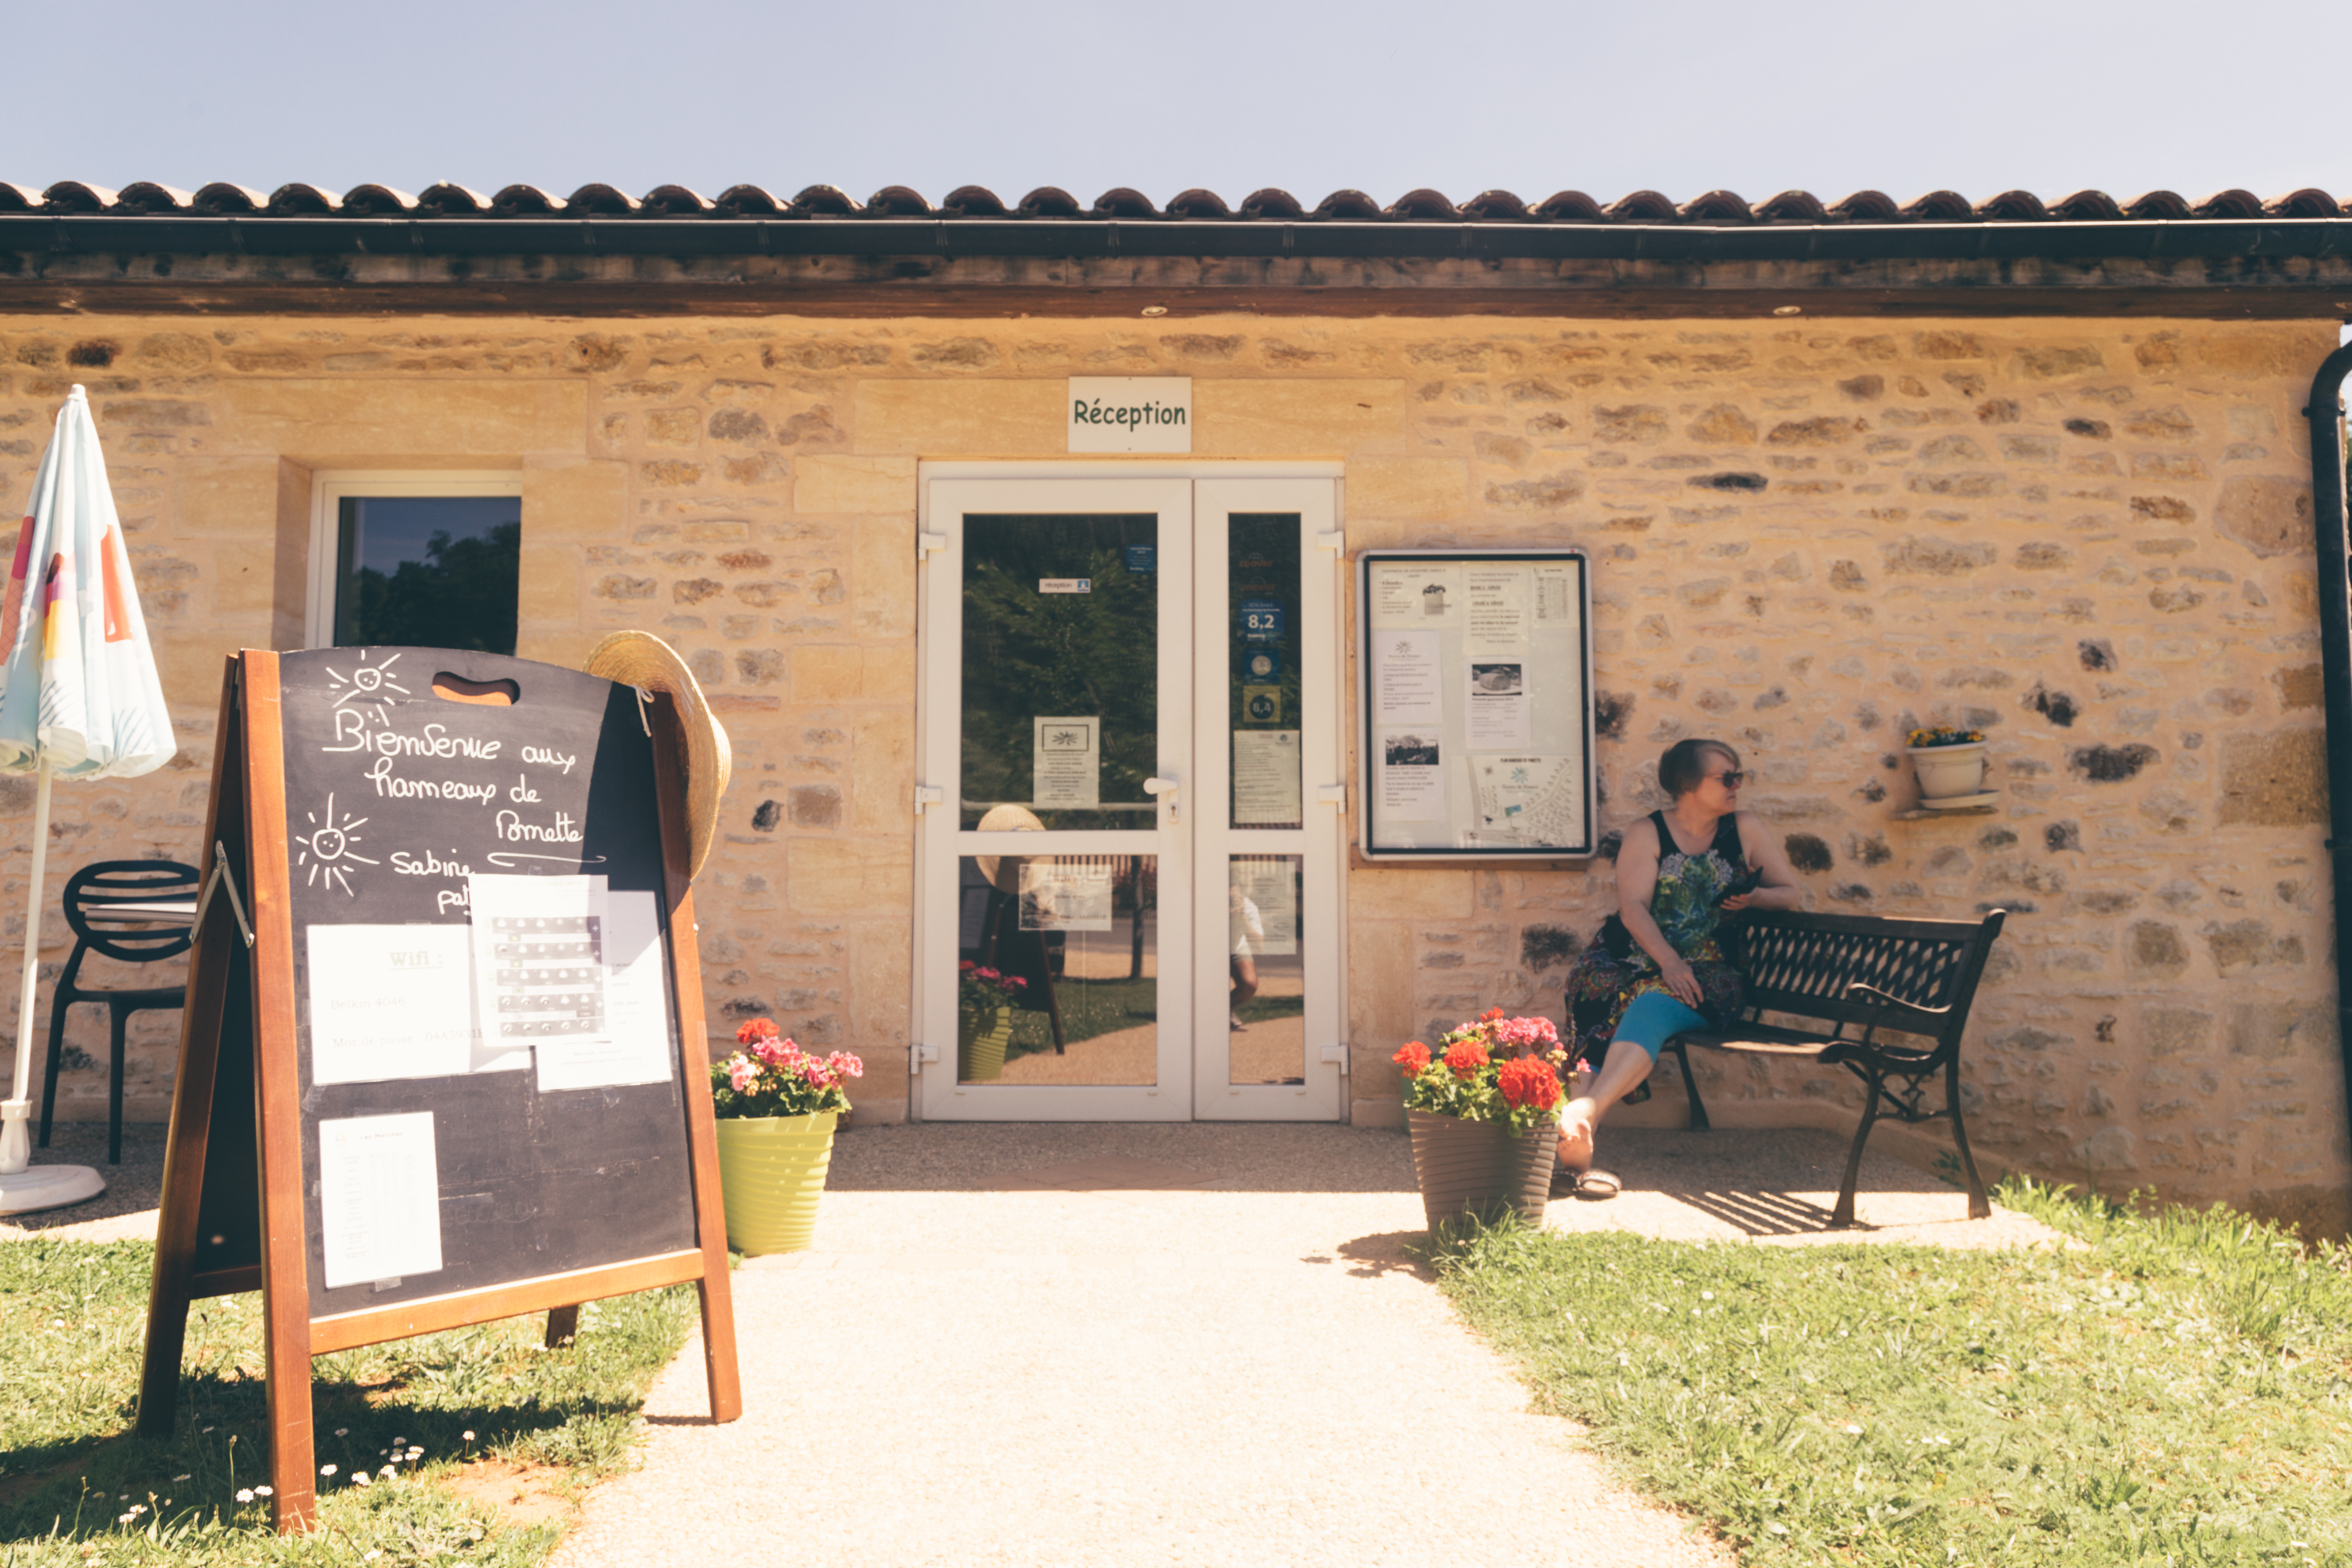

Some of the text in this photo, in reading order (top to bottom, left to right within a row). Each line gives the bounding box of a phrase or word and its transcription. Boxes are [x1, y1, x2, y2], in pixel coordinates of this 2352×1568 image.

[1075, 398, 1186, 432] Réception
[1248, 614, 1275, 630] 8,2
[521, 744, 576, 774] aux
[364, 756, 542, 806] hameaux de
[390, 848, 475, 876] Sabine
[330, 998, 371, 1010] Belkin
